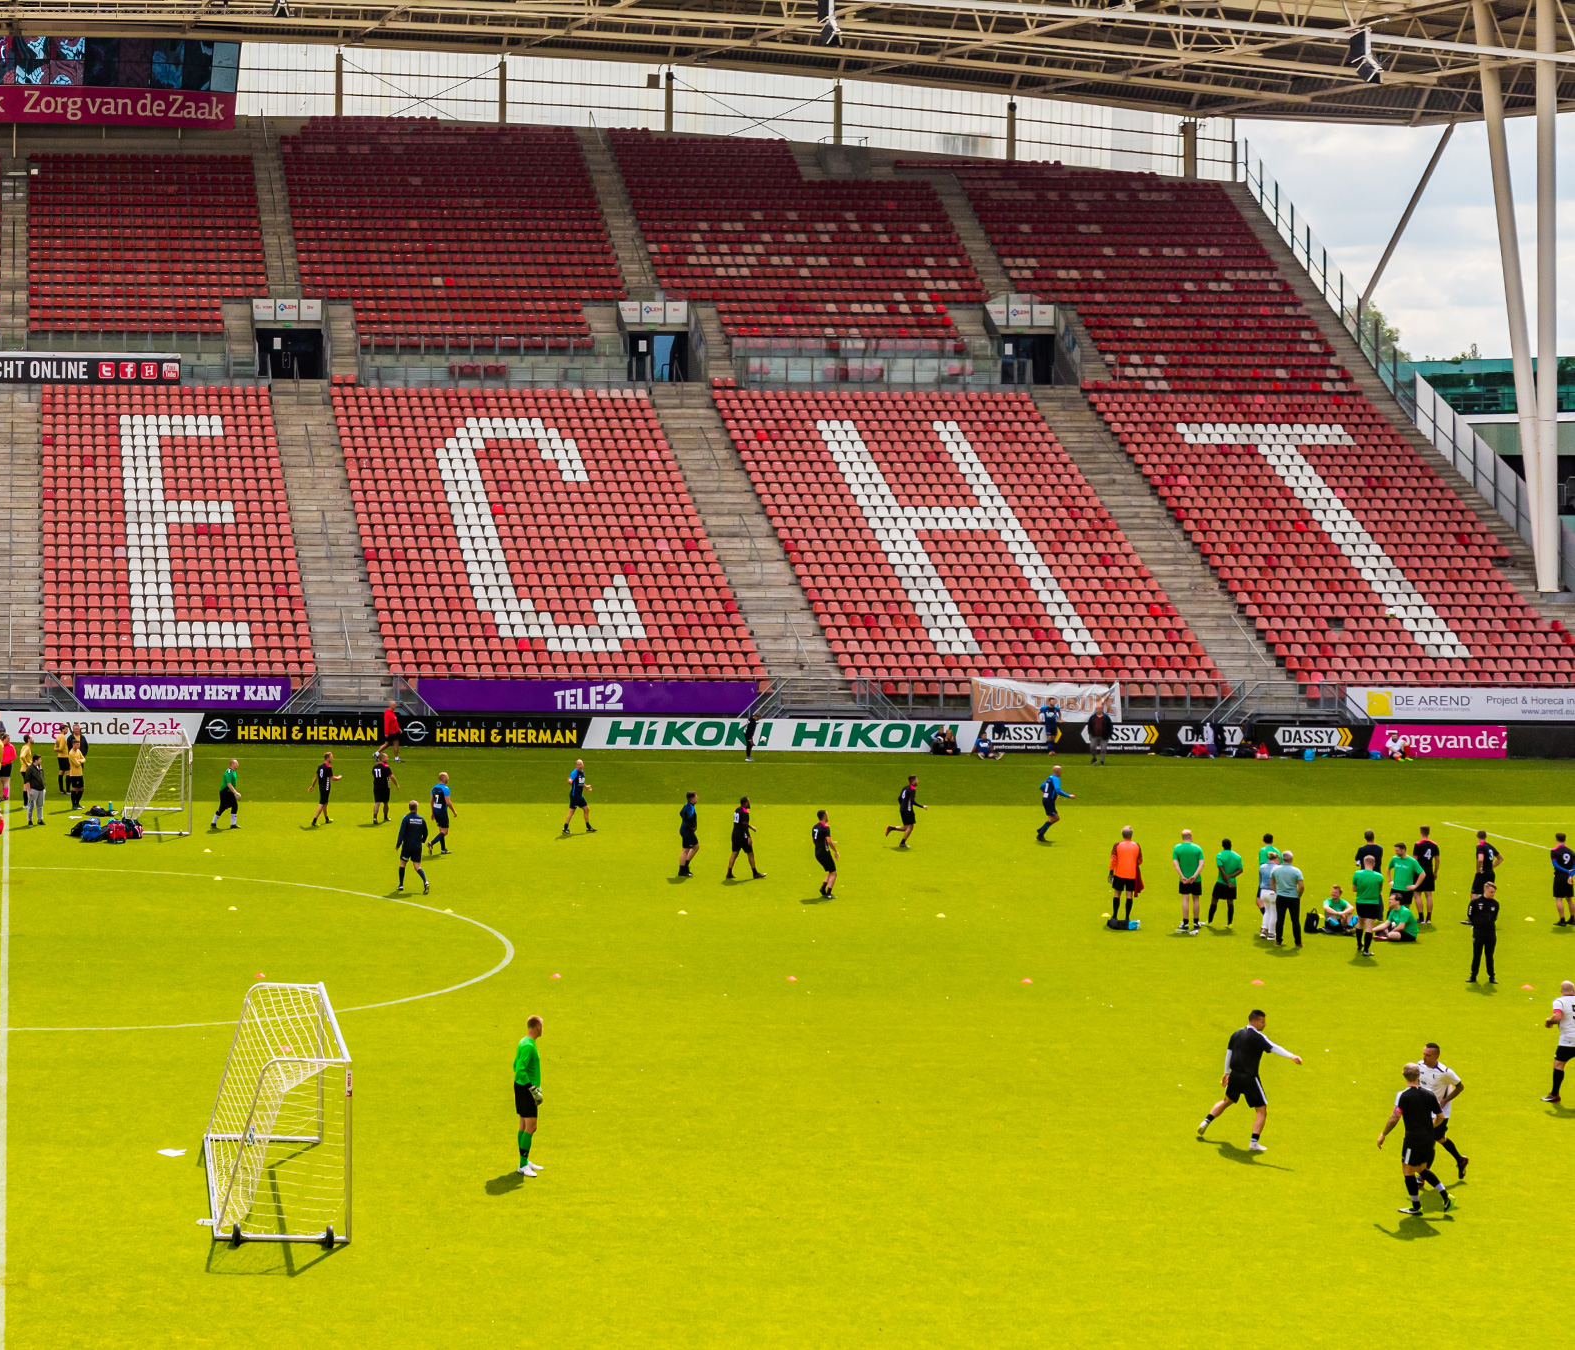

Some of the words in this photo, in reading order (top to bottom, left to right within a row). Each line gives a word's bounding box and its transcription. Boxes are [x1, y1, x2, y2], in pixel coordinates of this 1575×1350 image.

[24, 90, 82, 120] Zorg
[86, 97, 133, 115] van
[137, 93, 165, 116] de
[168, 95, 224, 120] Zaak
[30, 361, 89, 379] ONLINE
[84, 684, 136, 700] MAAR
[138, 684, 201, 700] OMDAT
[204, 685, 240, 700] HET
[243, 685, 282, 701] KAN
[554, 683, 623, 710] TELE2
[978, 684, 1027, 714] ZUID
[1395, 696, 1414, 706] DE
[1418, 696, 1470, 706] AREND
[1486, 695, 1519, 706] Project
[1521, 696, 1528, 705] &
[1531, 696, 1564, 705] Horeca
[18, 717, 64, 740] Zorg
[110, 717, 130, 735] de
[132, 718, 181, 736] Zaak
[237, 725, 286, 740] HENRI
[291, 726, 303, 740] &
[307, 726, 378, 741] HERMAN
[436, 728, 485, 743] HENRI
[490, 729, 502, 743] &
[506, 729, 577, 744] HERMAN
[1110, 728, 1140, 741] SSY
[1282, 729, 1334, 743] DASSY
[1434, 734, 1473, 749] van
[1475, 731, 1500, 749] de
[374, 769, 382, 777] 11
[813, 828, 819, 839] 7
[1424, 848, 1432, 860] 4
[1488, 848, 1494, 860] 3
[1563, 853, 1571, 864] 9
